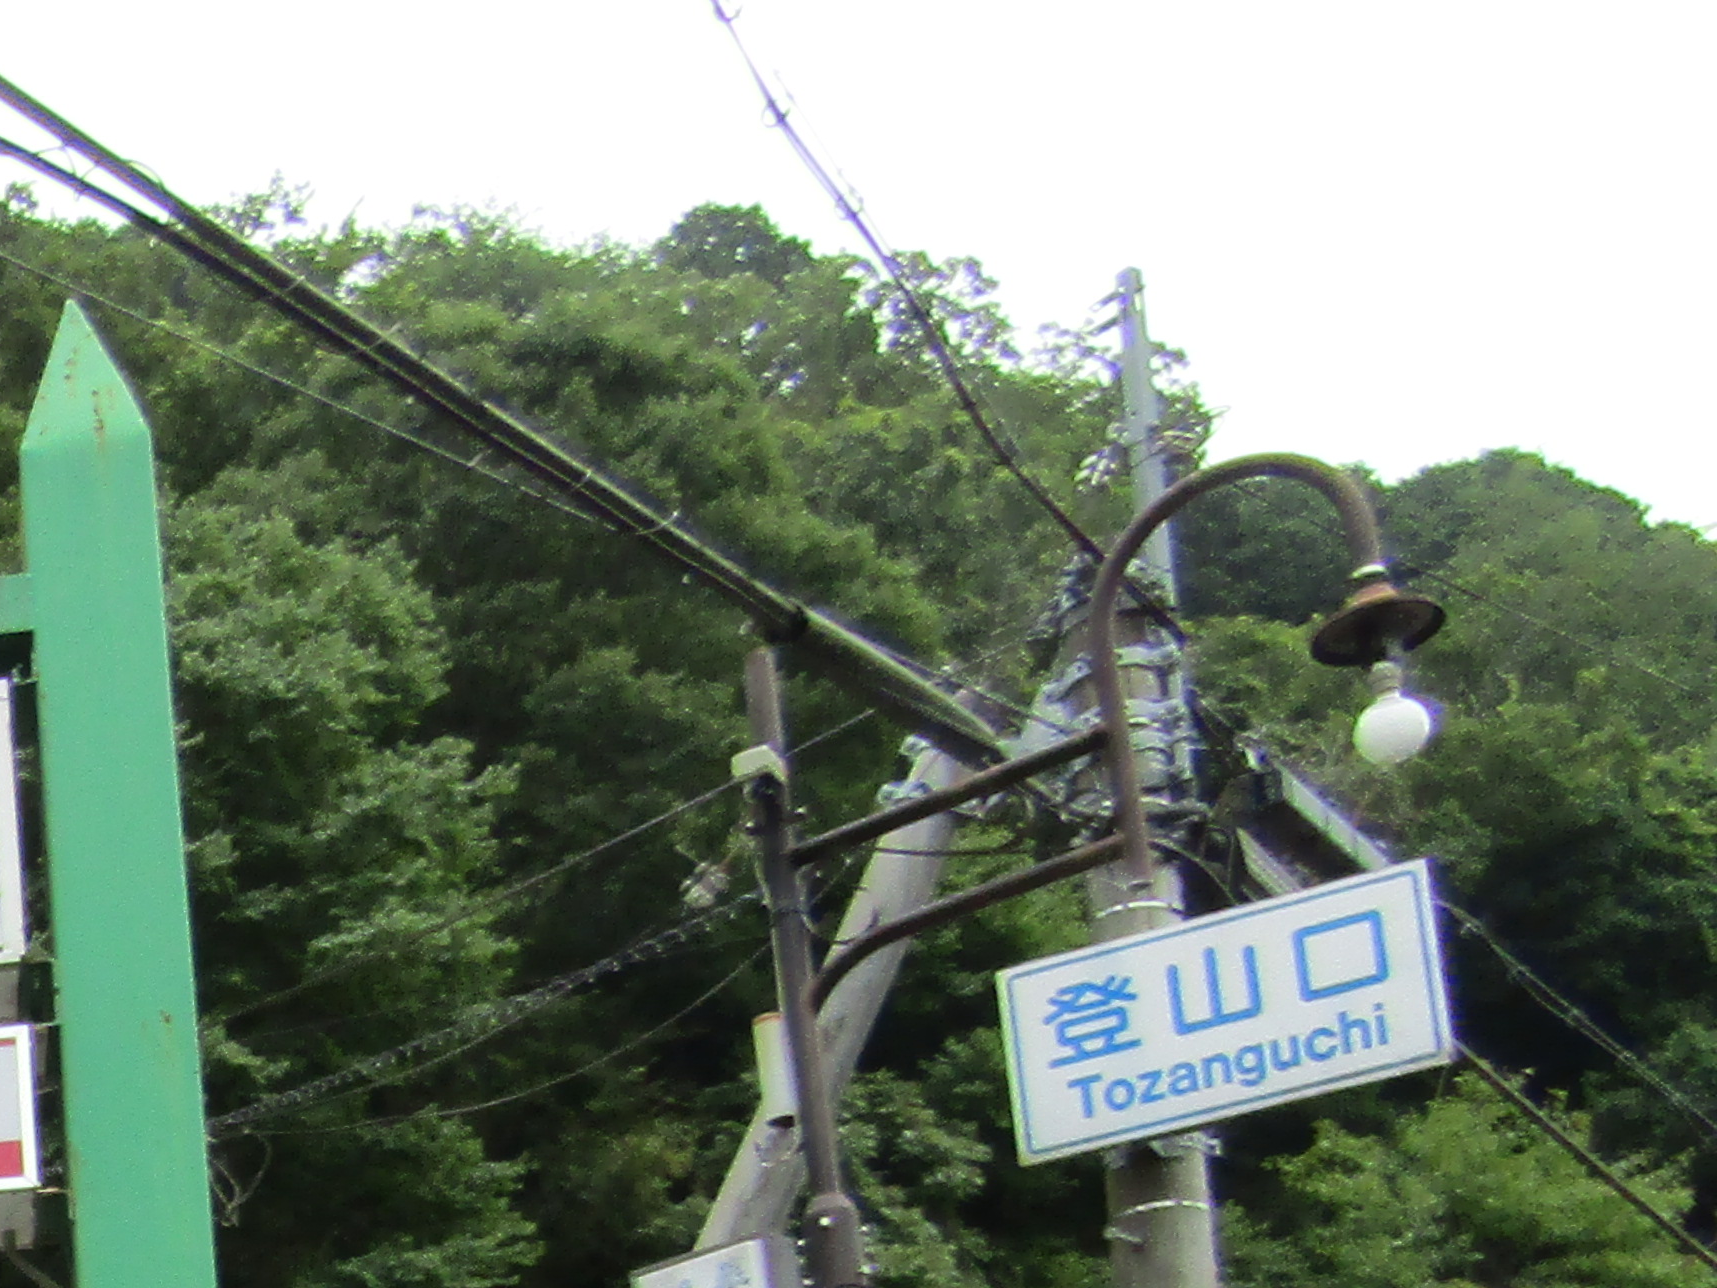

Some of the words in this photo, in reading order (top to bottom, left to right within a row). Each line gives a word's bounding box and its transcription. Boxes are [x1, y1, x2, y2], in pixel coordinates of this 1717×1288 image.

[1043, 909, 1390, 1069] 登山口
[1067, 1003, 1391, 1118] Tozanguchi
